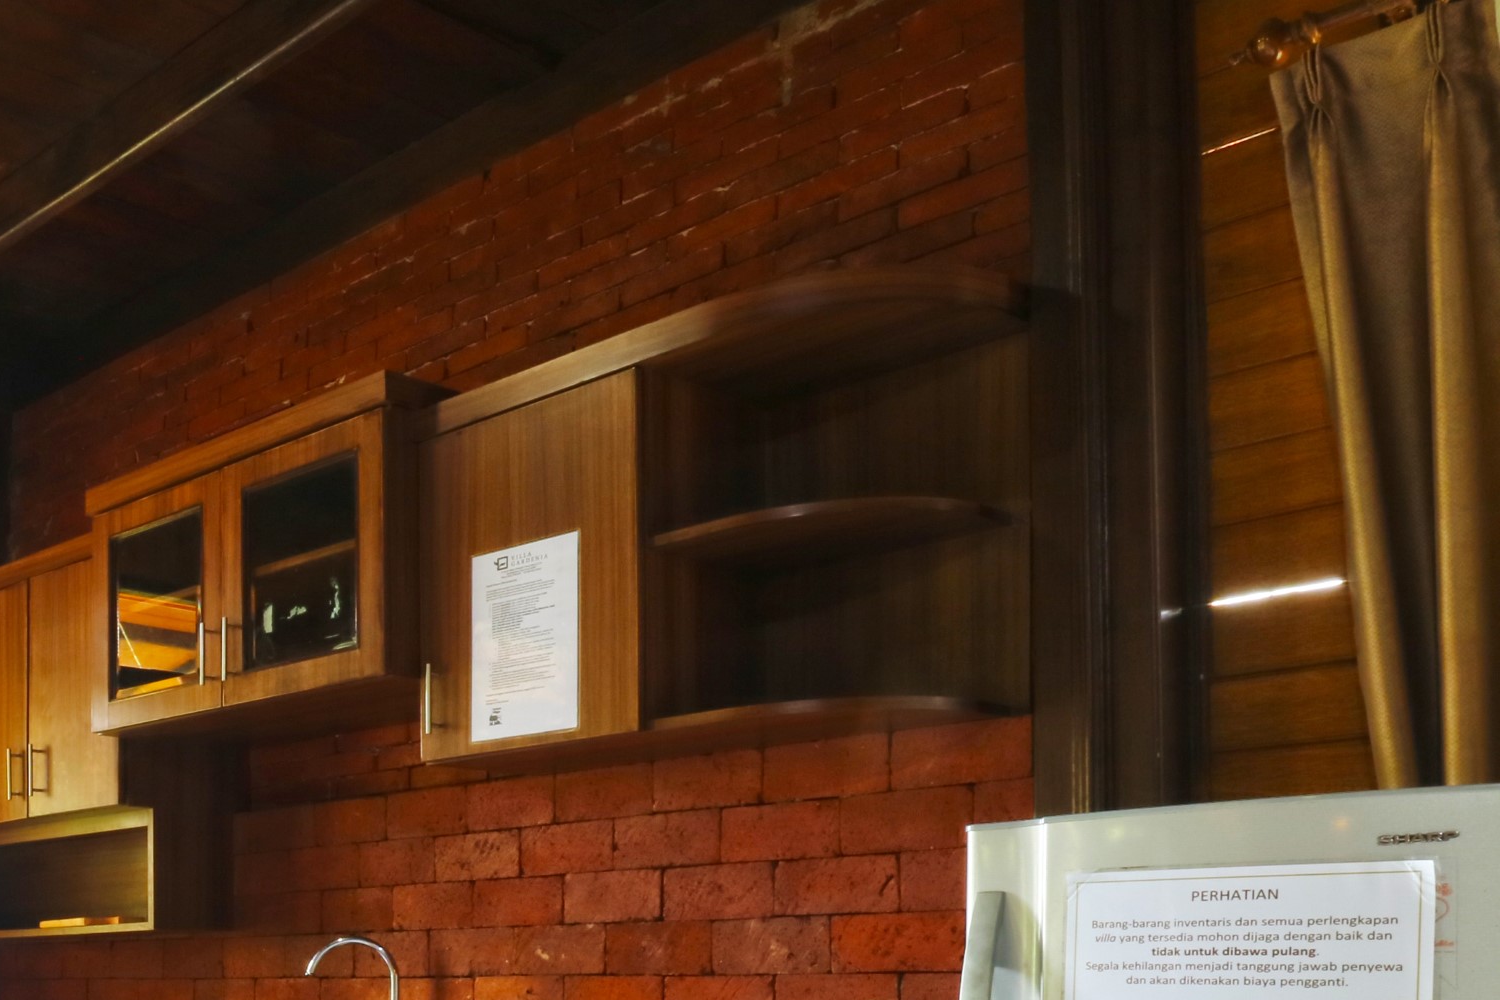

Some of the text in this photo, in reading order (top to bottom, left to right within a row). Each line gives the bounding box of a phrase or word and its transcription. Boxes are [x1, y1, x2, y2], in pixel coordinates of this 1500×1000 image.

[510, 551, 532, 560] VILLA
[1377, 829, 1460, 846] SHARP
[1191, 888, 1279, 903] PERHATIAN
[1091, 914, 1399, 931] Barang-barang inventaris dan semua perlengkapan
[1095, 930, 1393, 945] villa yang tersedia mohon dijaga dengan baik dan
[1151, 945, 1320, 959] tidak untuk dibawa pulang.
[1085, 960, 1404, 974] Segala kehilangan menjadi tanggung jawab penyewa
[1125, 975, 1349, 989] dan akan dikenakan biaya pengganti.
